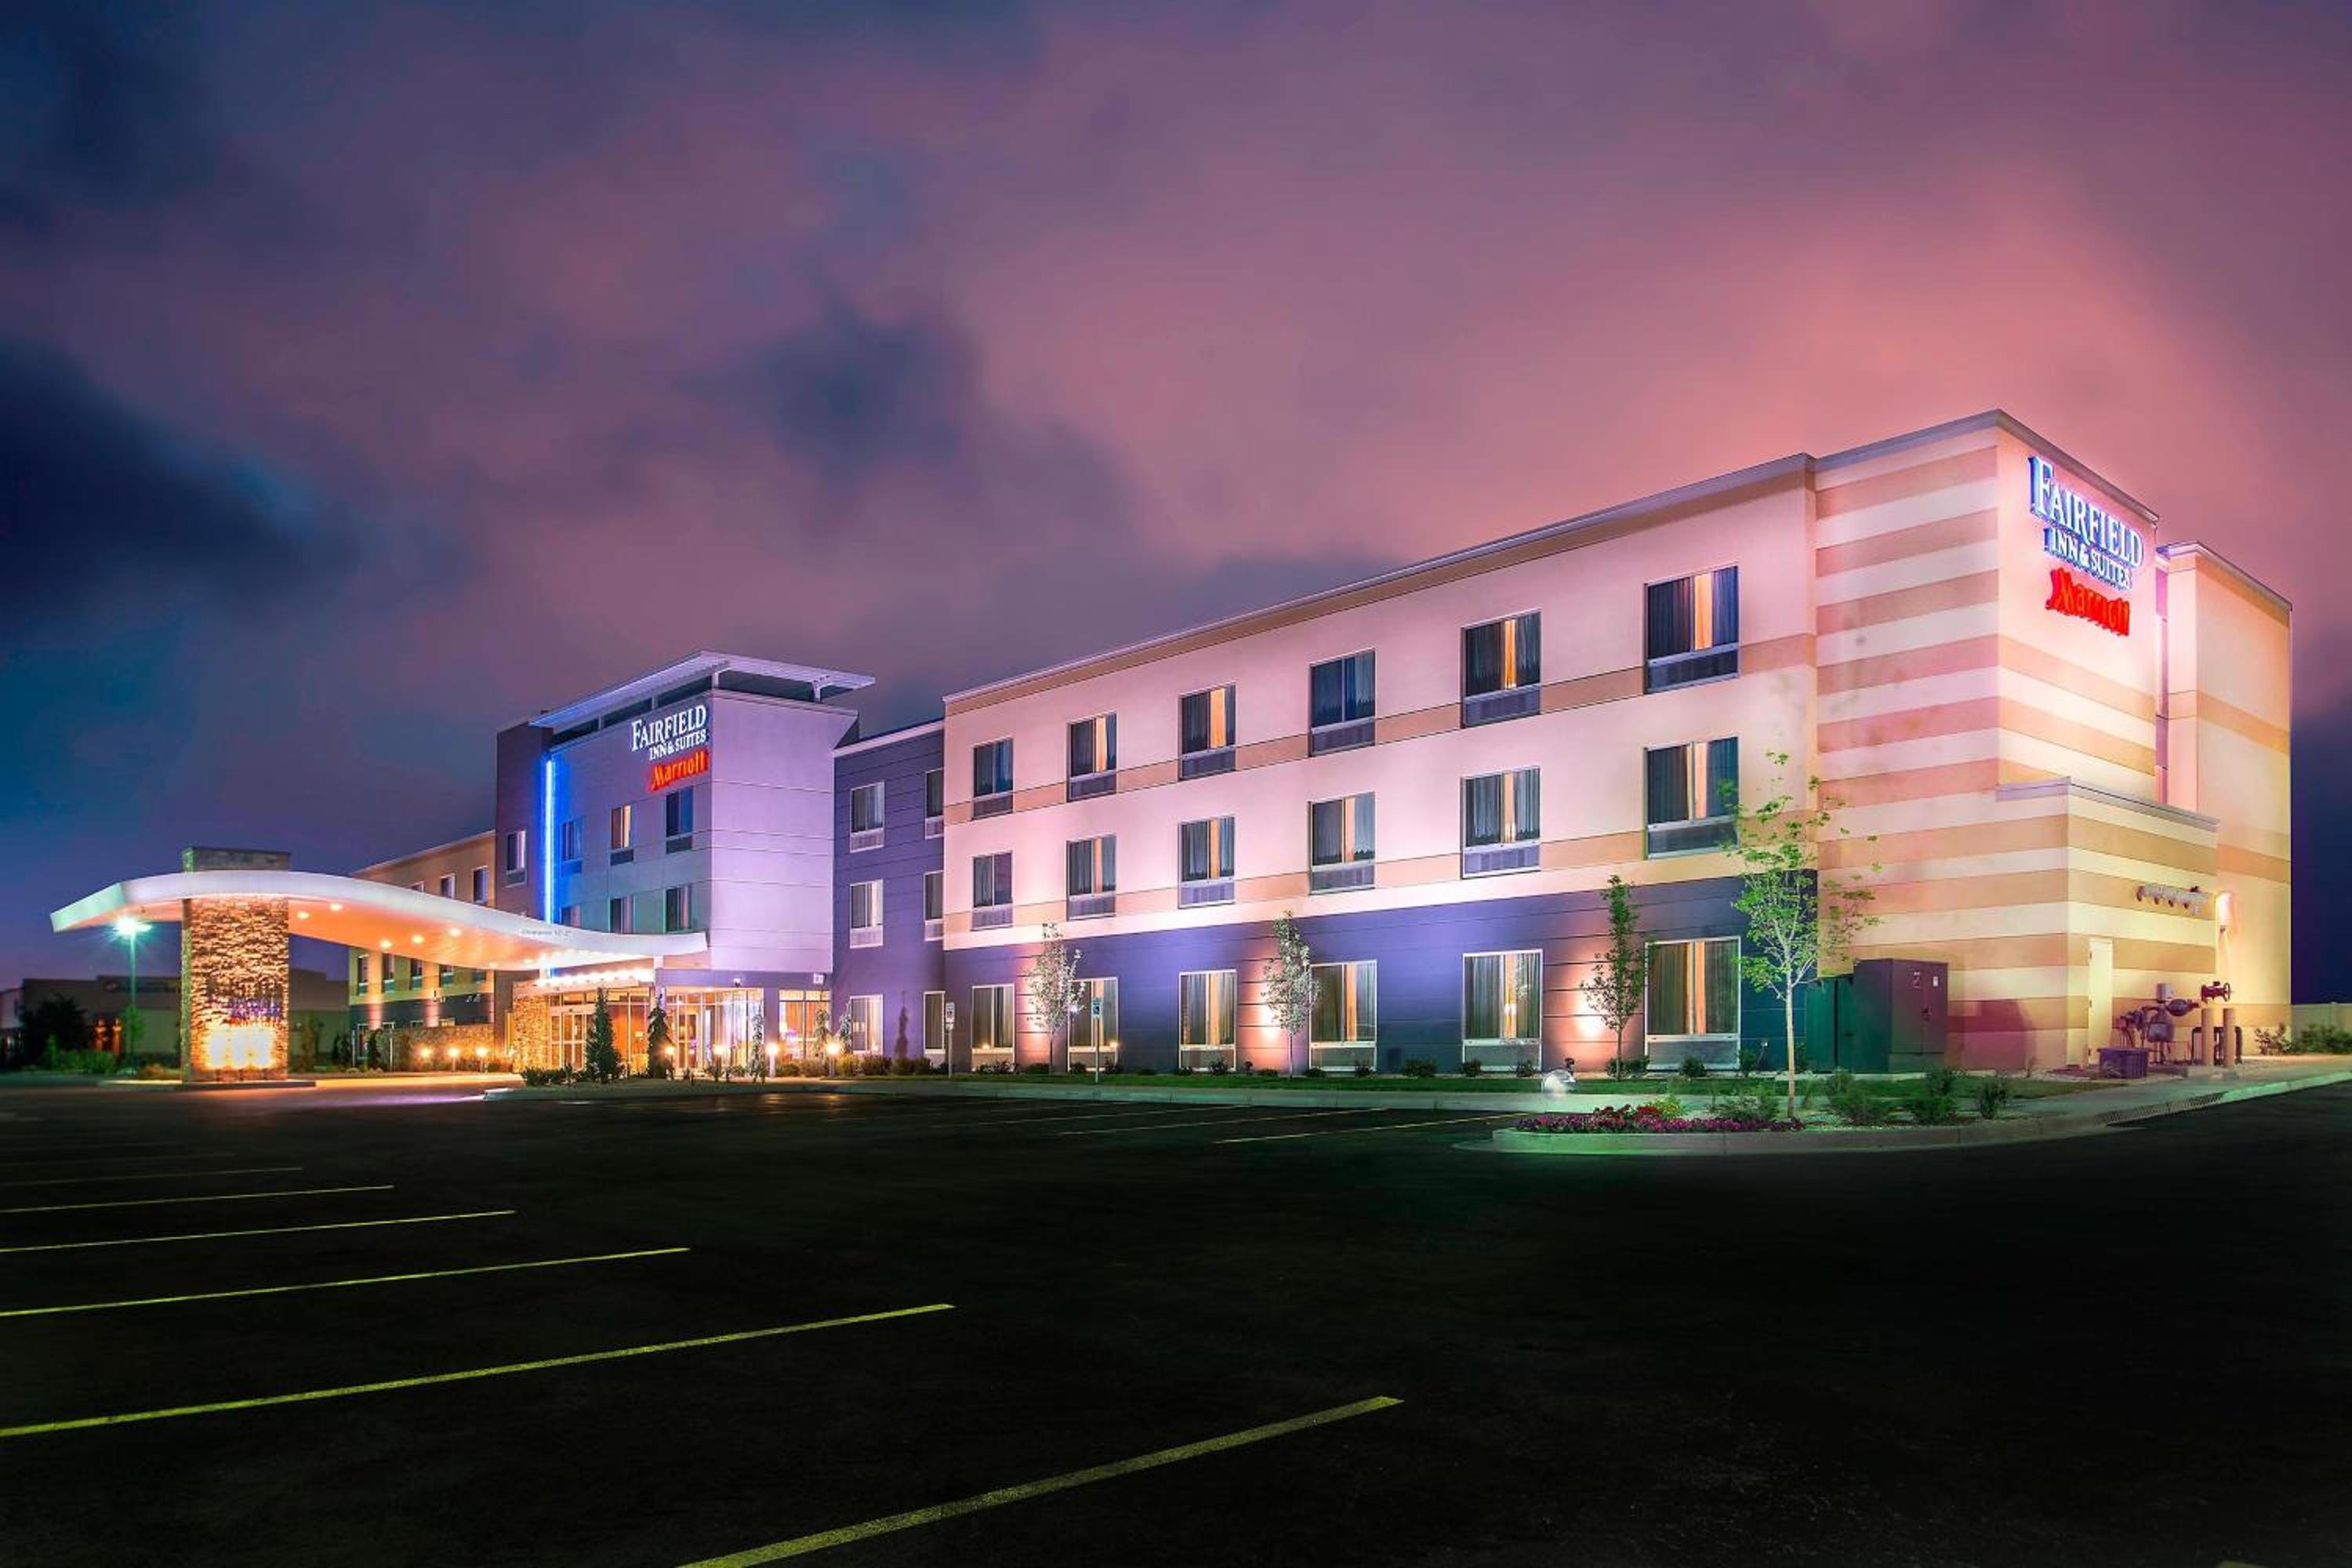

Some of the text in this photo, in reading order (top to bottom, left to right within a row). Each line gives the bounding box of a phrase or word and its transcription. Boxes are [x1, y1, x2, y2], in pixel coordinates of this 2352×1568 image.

[2027, 456, 2144, 569] FAIRFIELD
[2043, 527, 2082, 560] INN
[2090, 551, 2132, 590] SUITES
[2045, 567, 2130, 637] Marriott
[631, 705, 707, 752] FAIRFIELD
[649, 742, 666, 761] INN
[675, 728, 706, 752] SUITES
[651, 750, 708, 791] Marriott
